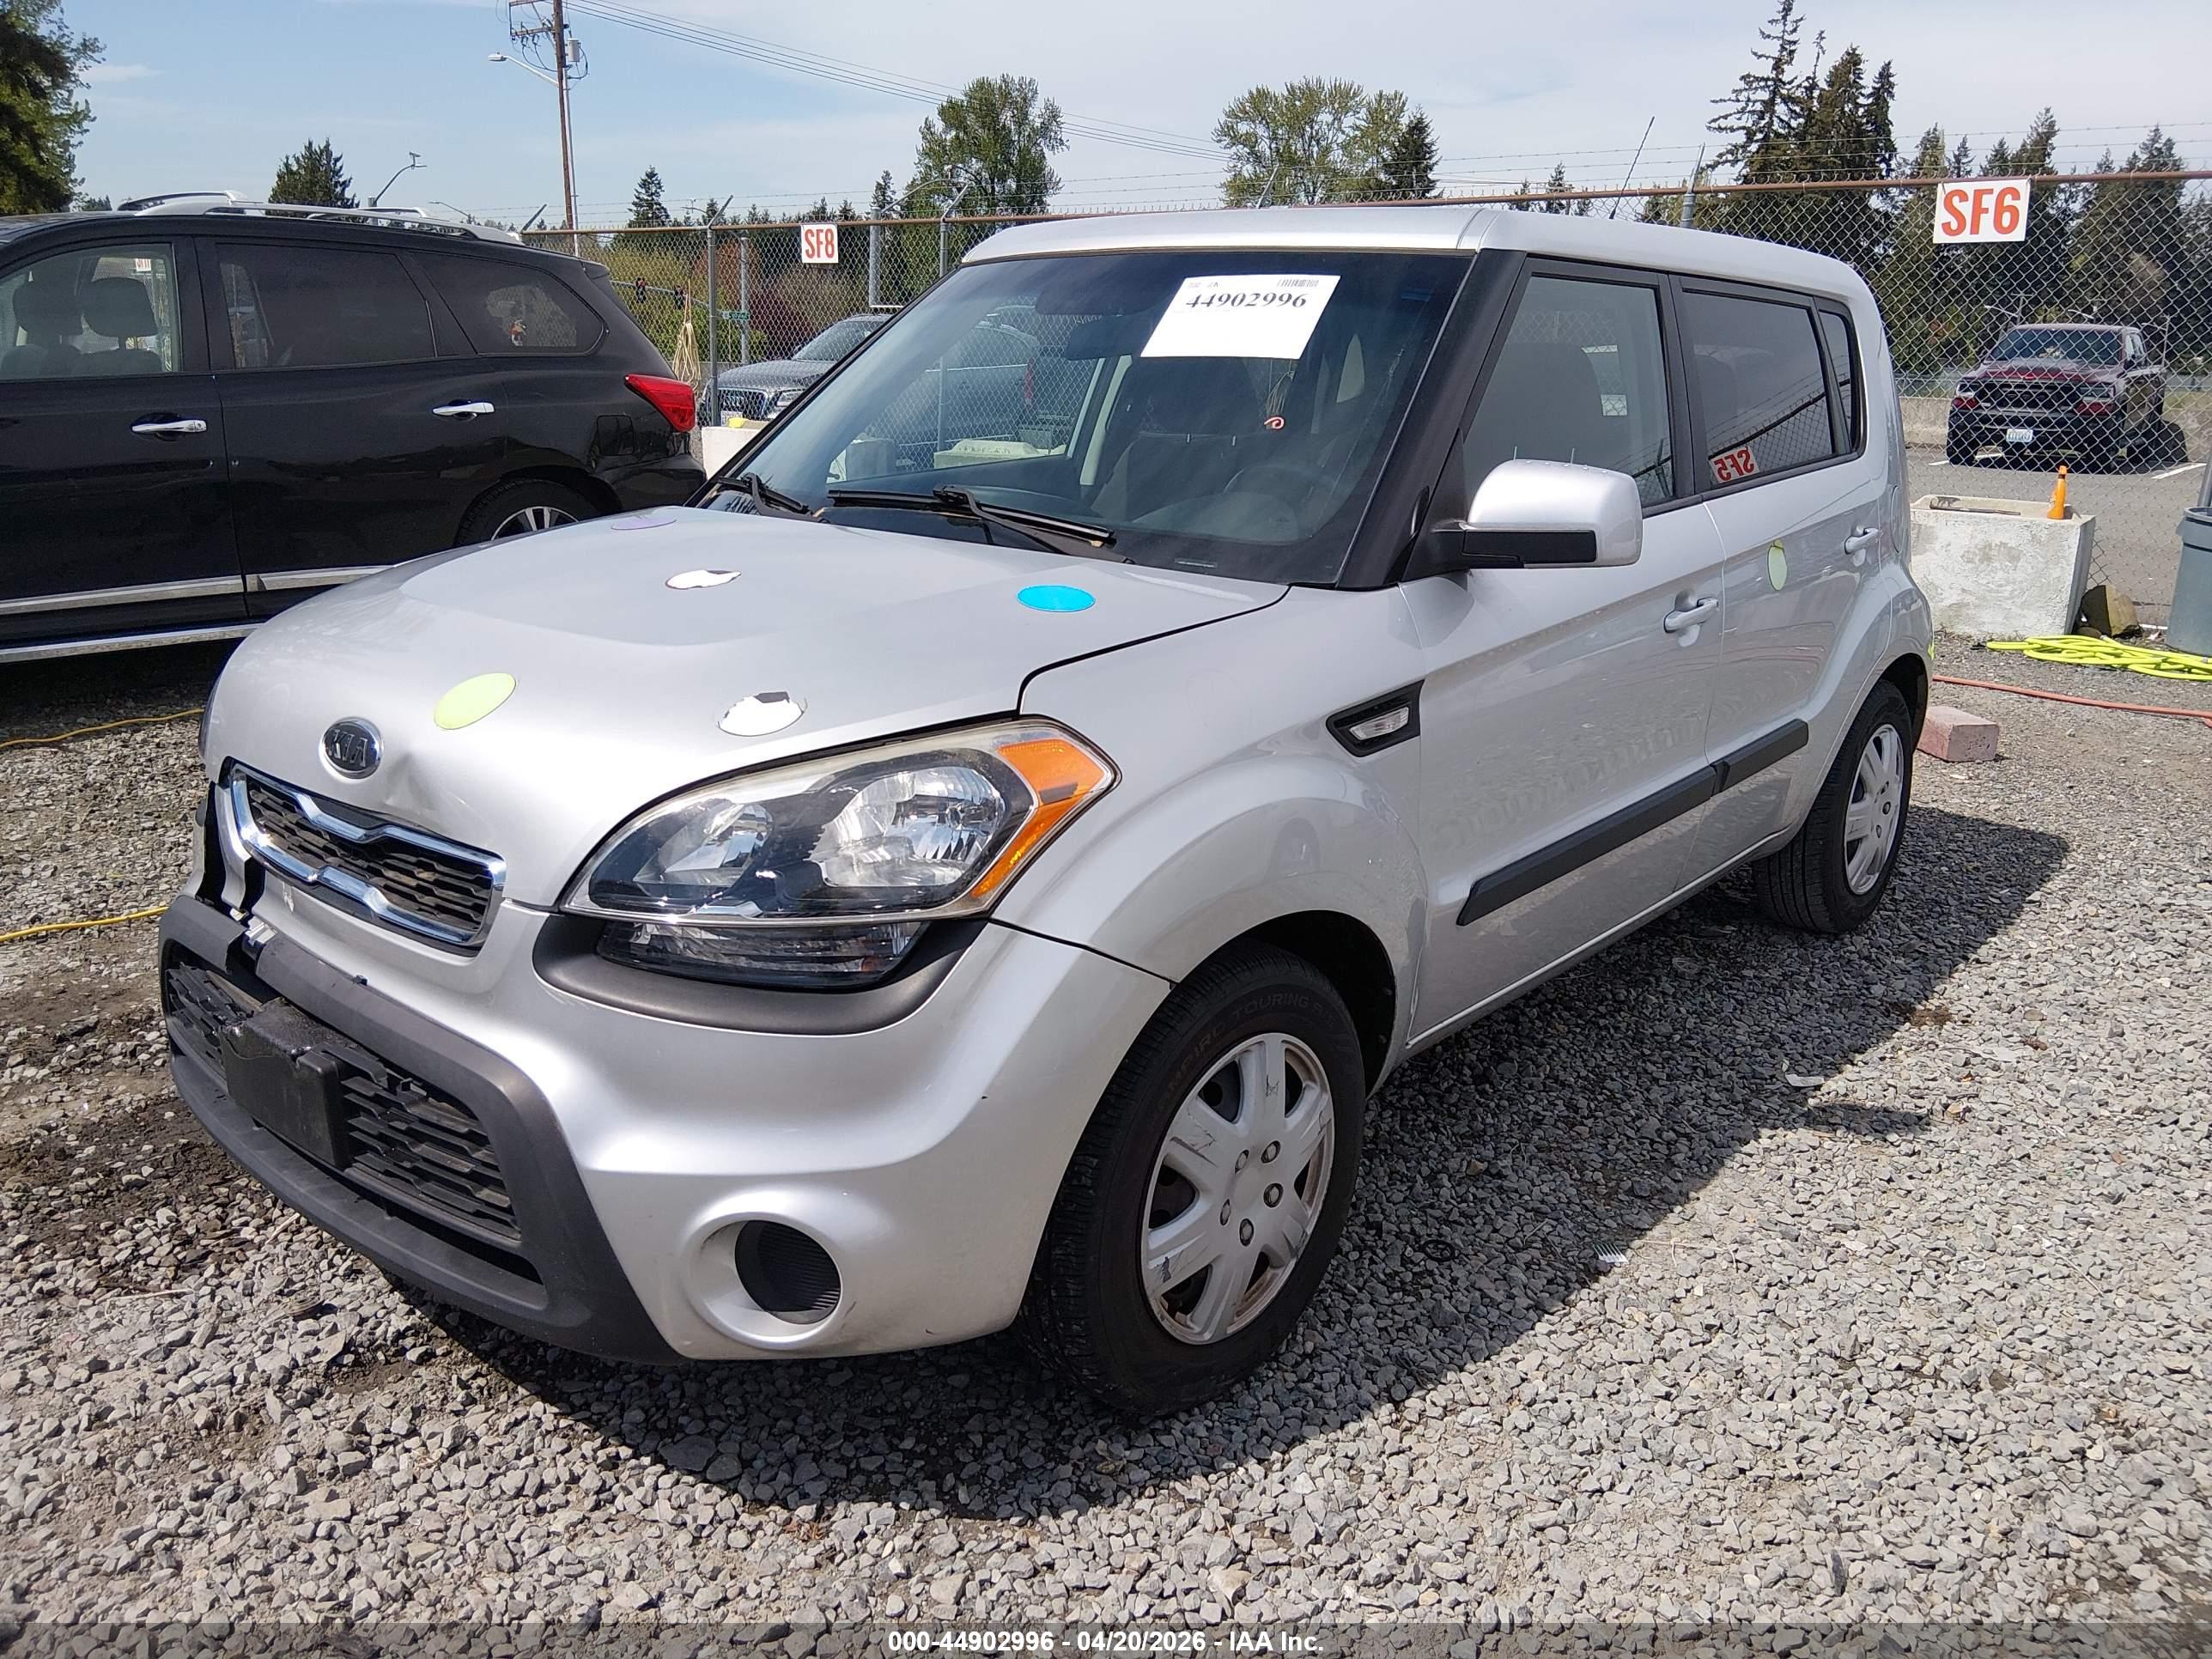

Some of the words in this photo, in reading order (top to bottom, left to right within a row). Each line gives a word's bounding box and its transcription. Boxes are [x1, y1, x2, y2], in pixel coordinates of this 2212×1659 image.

[1942, 187, 2021, 236] SF6
[805, 228, 835, 258] SF8
[1186, 292, 1310, 307] 44902996
[329, 729, 368, 767] KIA
[1232, 992, 1310, 1018] TOURING
